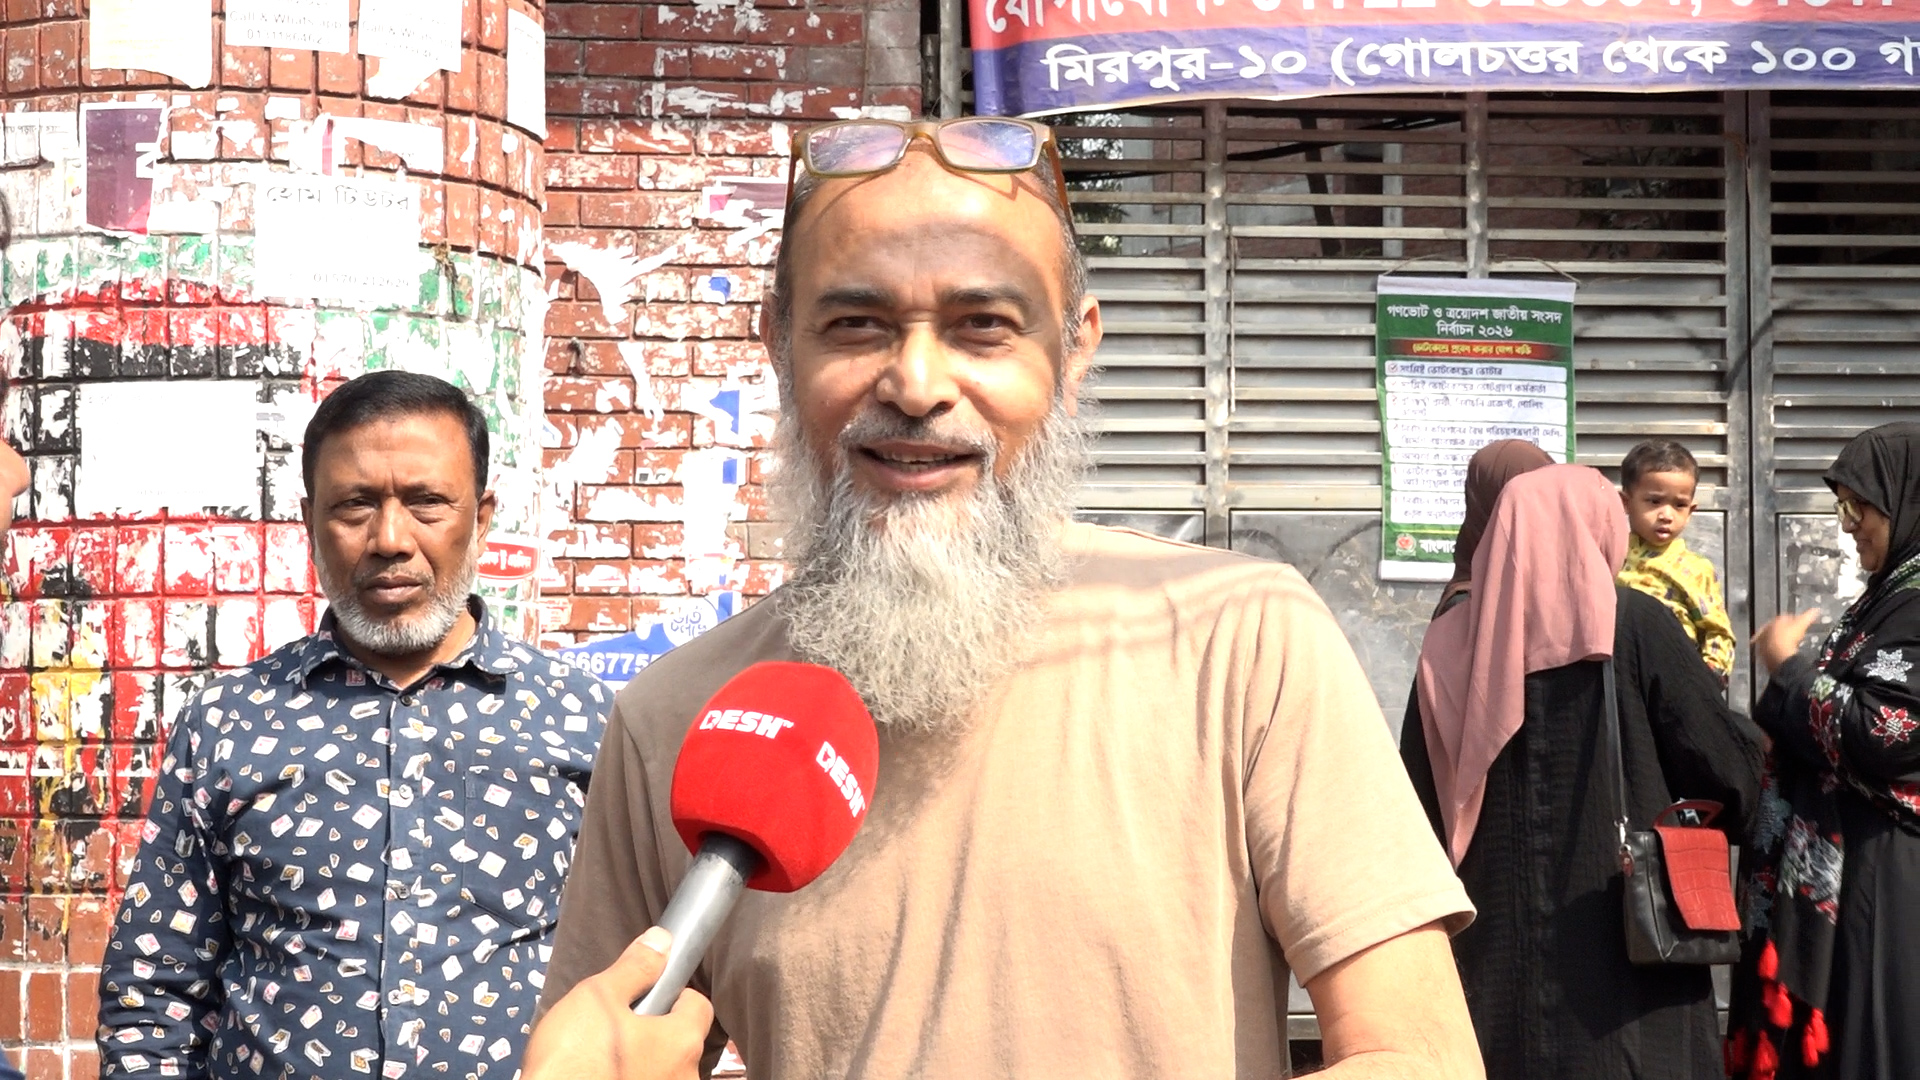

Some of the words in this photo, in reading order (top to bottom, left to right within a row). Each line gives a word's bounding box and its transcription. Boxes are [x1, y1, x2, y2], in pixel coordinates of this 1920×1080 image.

[1041, 42, 1307, 91] মিরপুর-১০
[1330, 36, 1583, 87] (গোলচত্তর
[1602, 35, 1730, 75] থেকে
[1751, 40, 1856, 75] ১০০
[1879, 35, 1920, 76] গ
[266, 186, 321, 203] হোম
[335, 184, 409, 210] টিউটর
[1387, 303, 1430, 318] গণভোট
[1433, 307, 1443, 319] ও
[1446, 306, 1489, 320] ত্রয়োদশ
[1492, 305, 1528, 321] জাতীয়
[1531, 311, 1563, 324] সংসদ
[1436, 322, 1475, 336] নির্বাচন
[1478, 326, 1514, 338] ২০২৬
[699, 709, 794, 739] DESH
